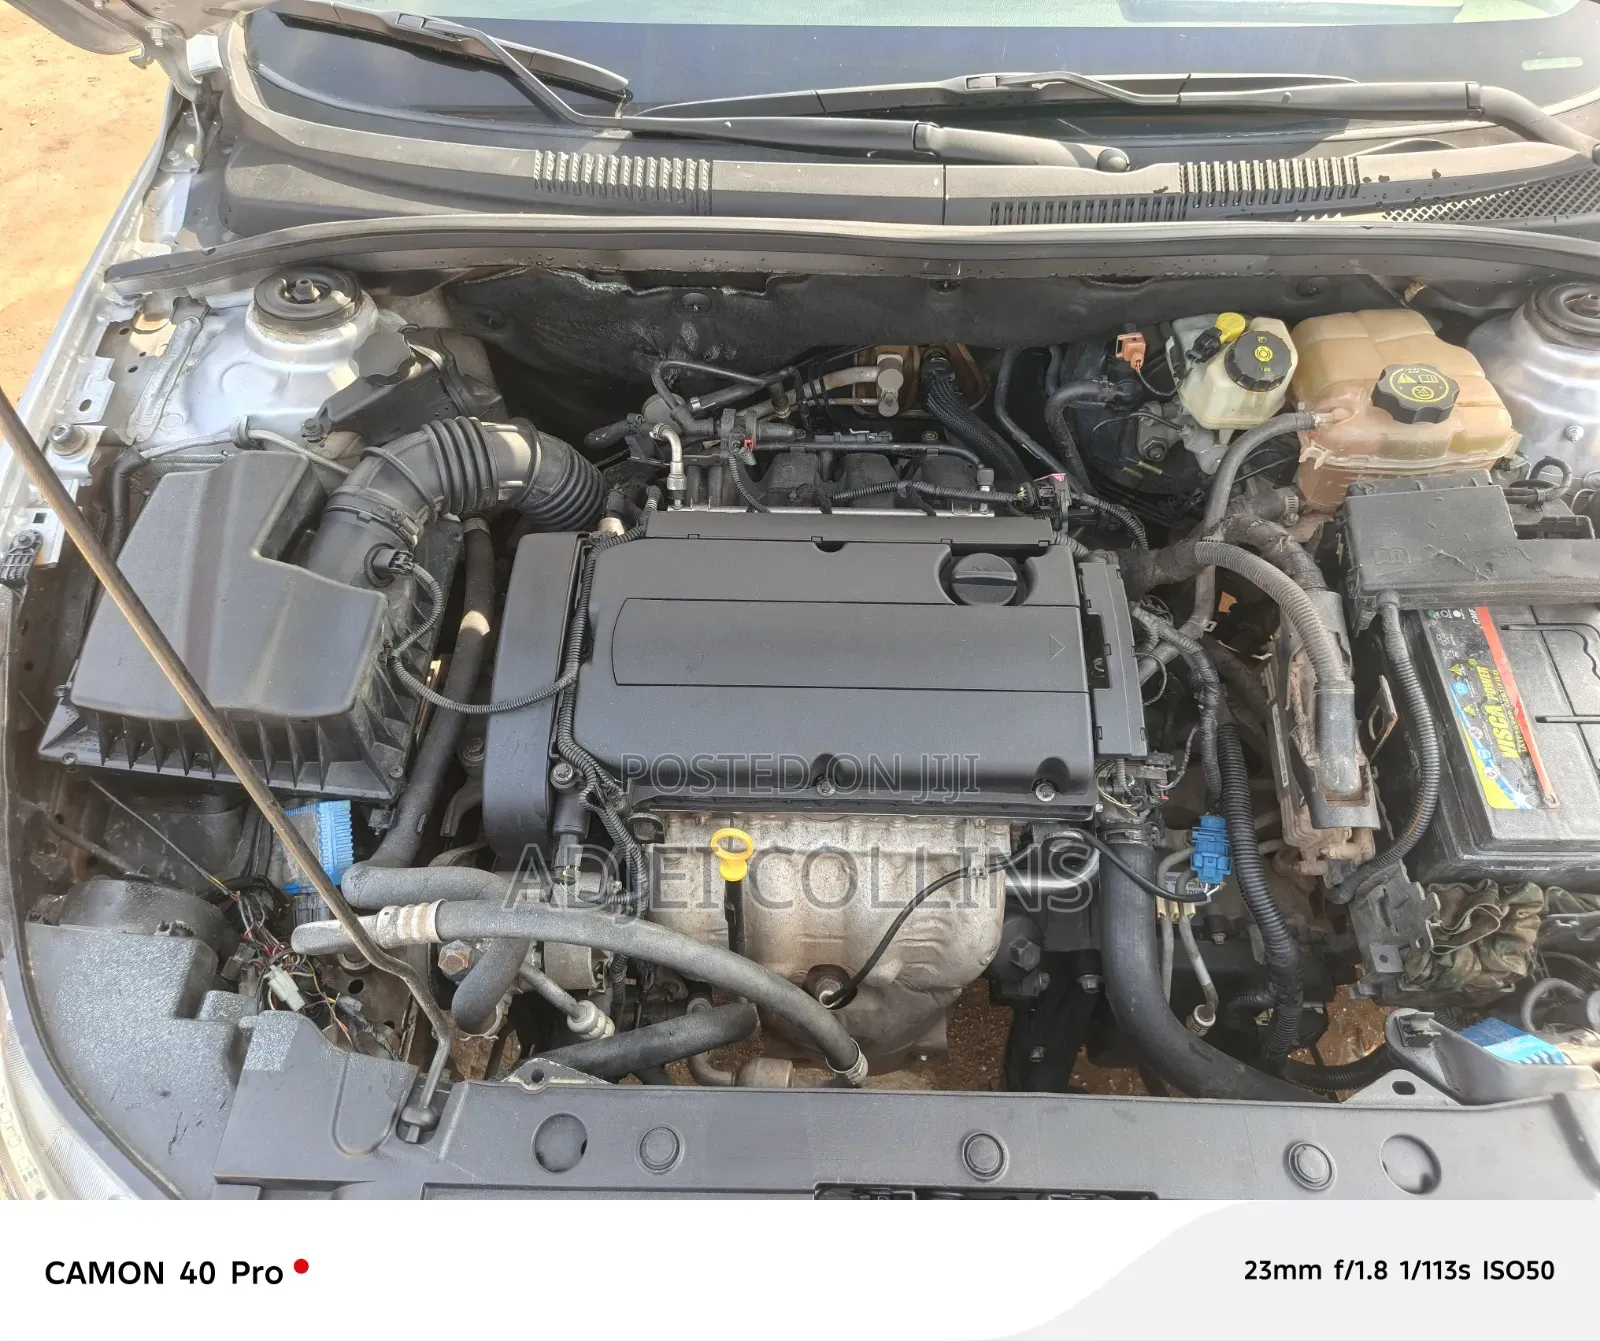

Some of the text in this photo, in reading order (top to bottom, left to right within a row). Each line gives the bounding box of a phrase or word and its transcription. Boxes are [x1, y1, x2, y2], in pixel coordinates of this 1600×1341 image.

[1476, 666, 1499, 702] POWER
[1492, 669, 1511, 708] CERTIFIED
[1484, 705, 1520, 759] VISCA
